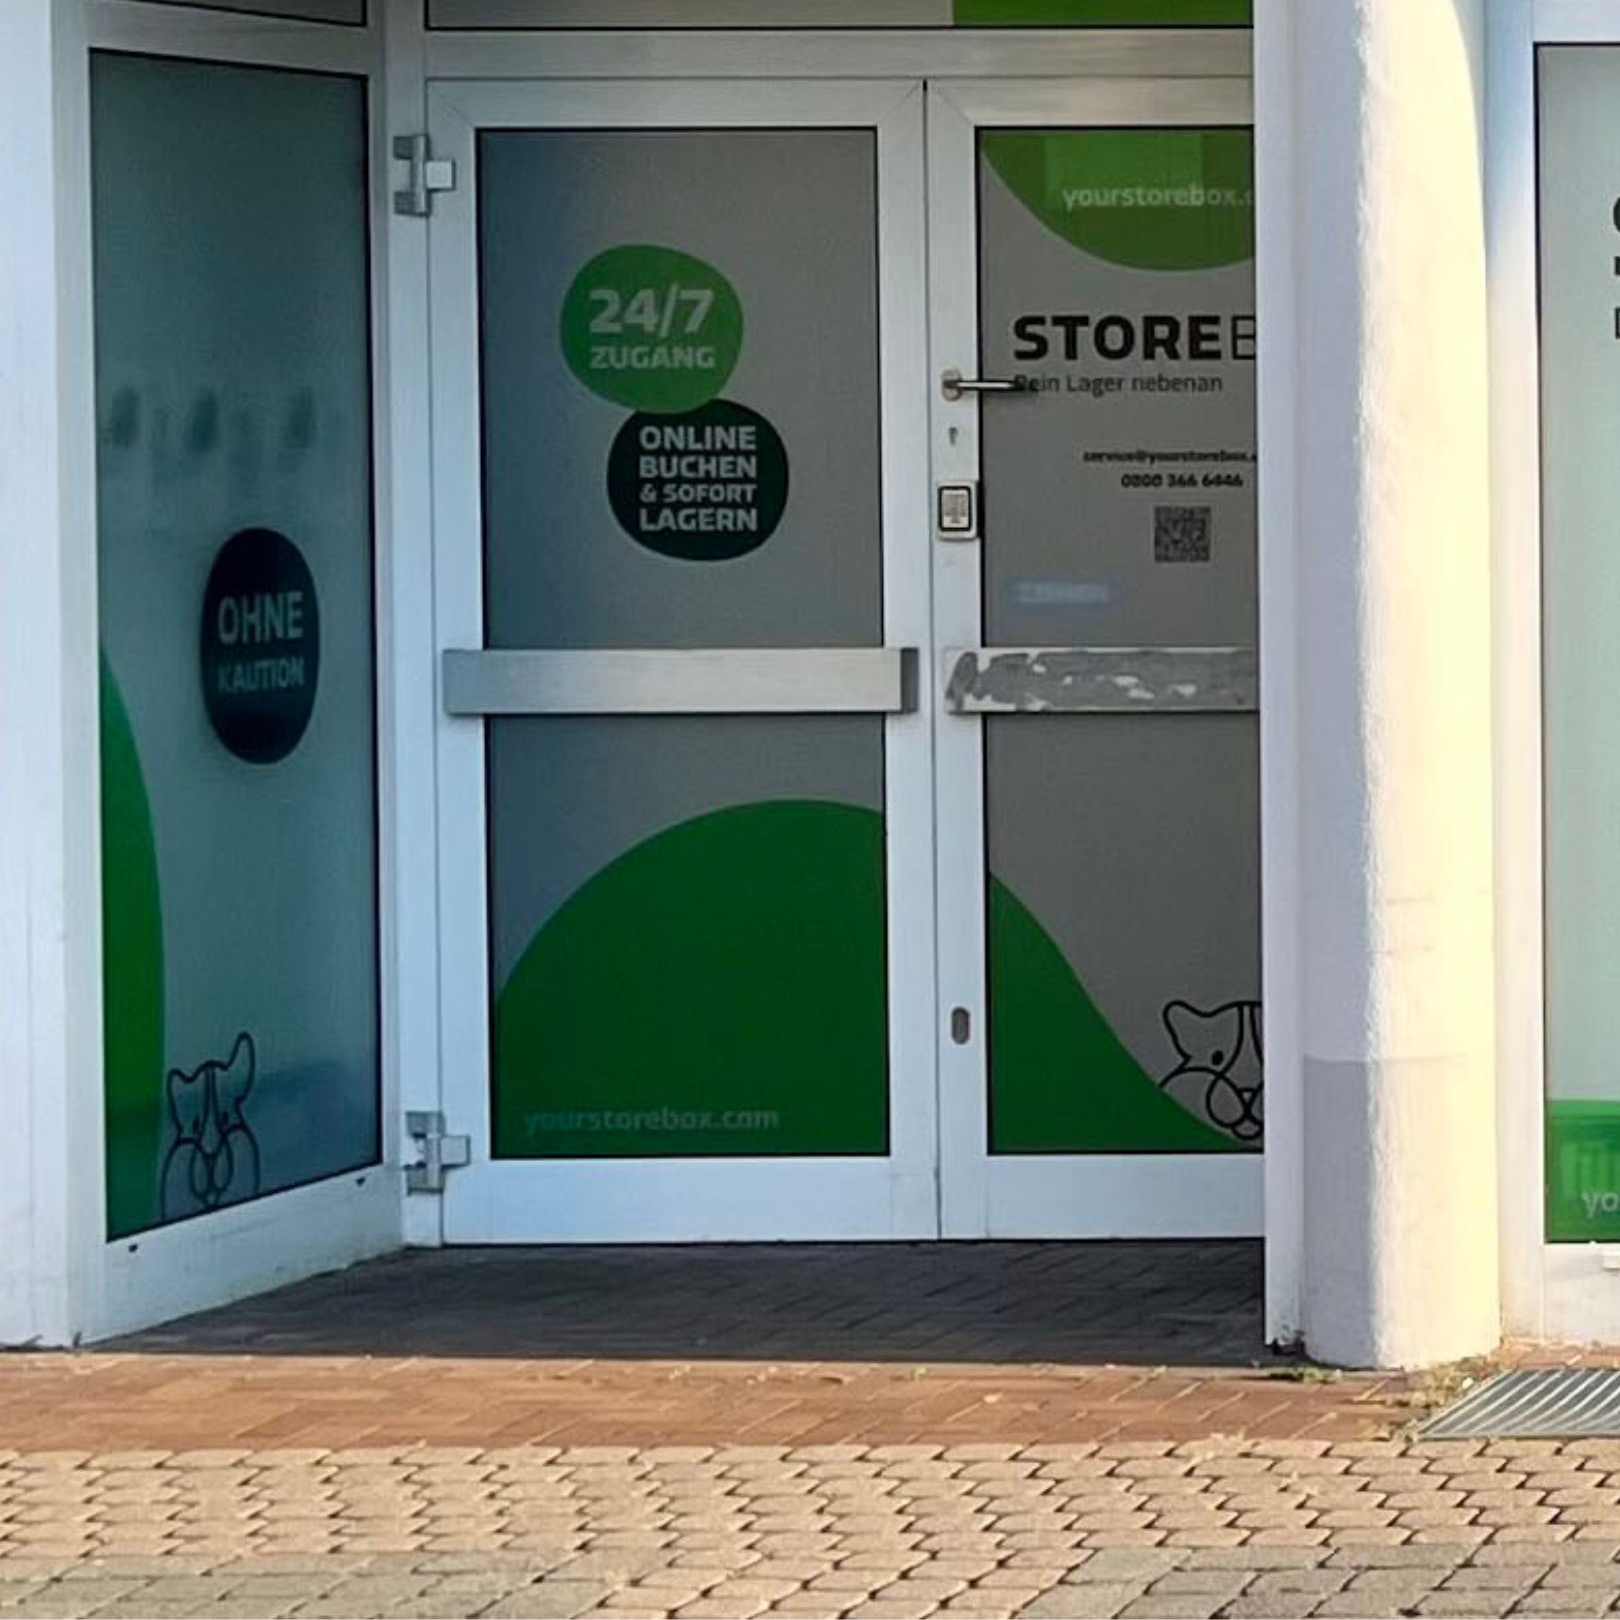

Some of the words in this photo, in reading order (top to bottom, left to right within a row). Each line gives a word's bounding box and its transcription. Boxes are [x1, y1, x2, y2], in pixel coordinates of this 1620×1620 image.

[589, 283, 713, 337] 24/7
[590, 346, 715, 368] ZUGANG
[1067, 375, 1123, 397] Lager
[1131, 373, 1223, 391] nebenan
[639, 426, 756, 450] ONLINE
[639, 456, 757, 478] BUCHEN
[1121, 474, 1162, 487] 0800
[640, 484, 656, 502] &
[663, 484, 757, 502] SOFORT
[639, 508, 757, 530] LAGERN
[219, 591, 303, 643] OHNE
[219, 657, 304, 693] KAUTION
[524, 1106, 779, 1146] yourstorebox.com
